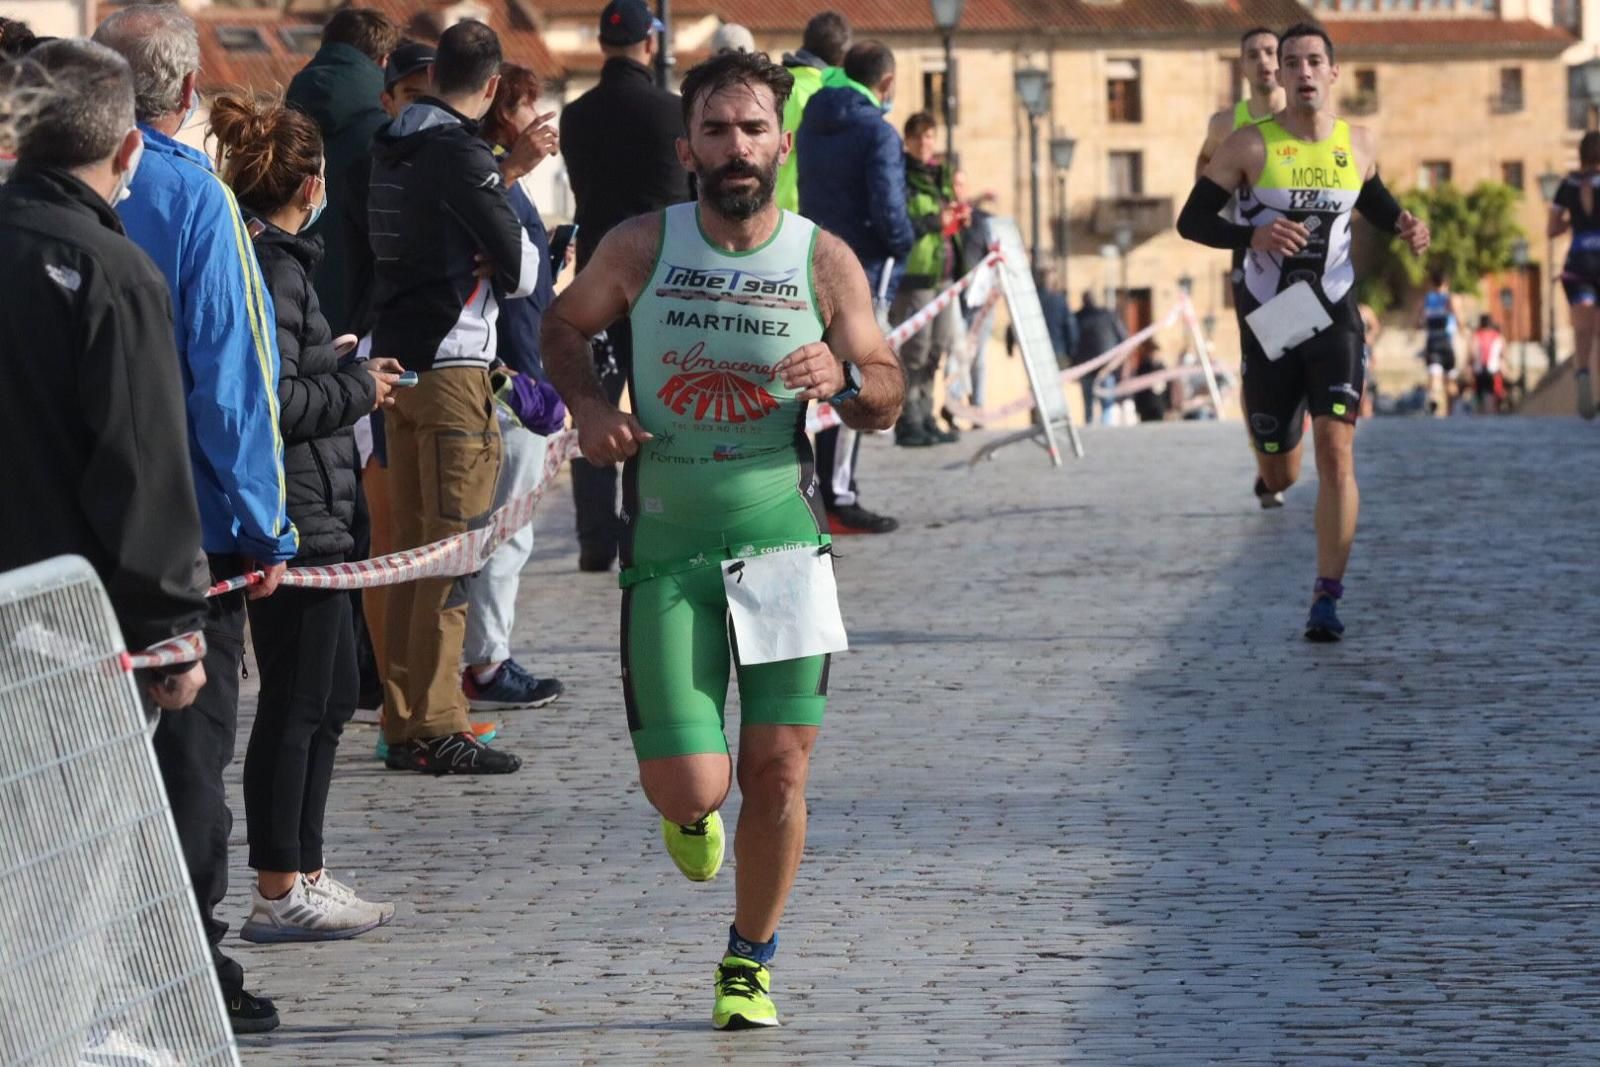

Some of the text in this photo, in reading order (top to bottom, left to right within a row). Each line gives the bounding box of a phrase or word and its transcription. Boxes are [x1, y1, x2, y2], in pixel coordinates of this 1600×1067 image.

[1292, 167, 1341, 188] MORLA
[1288, 189, 1320, 200] TRI
[666, 310, 790, 337] MARTÍNEZ
